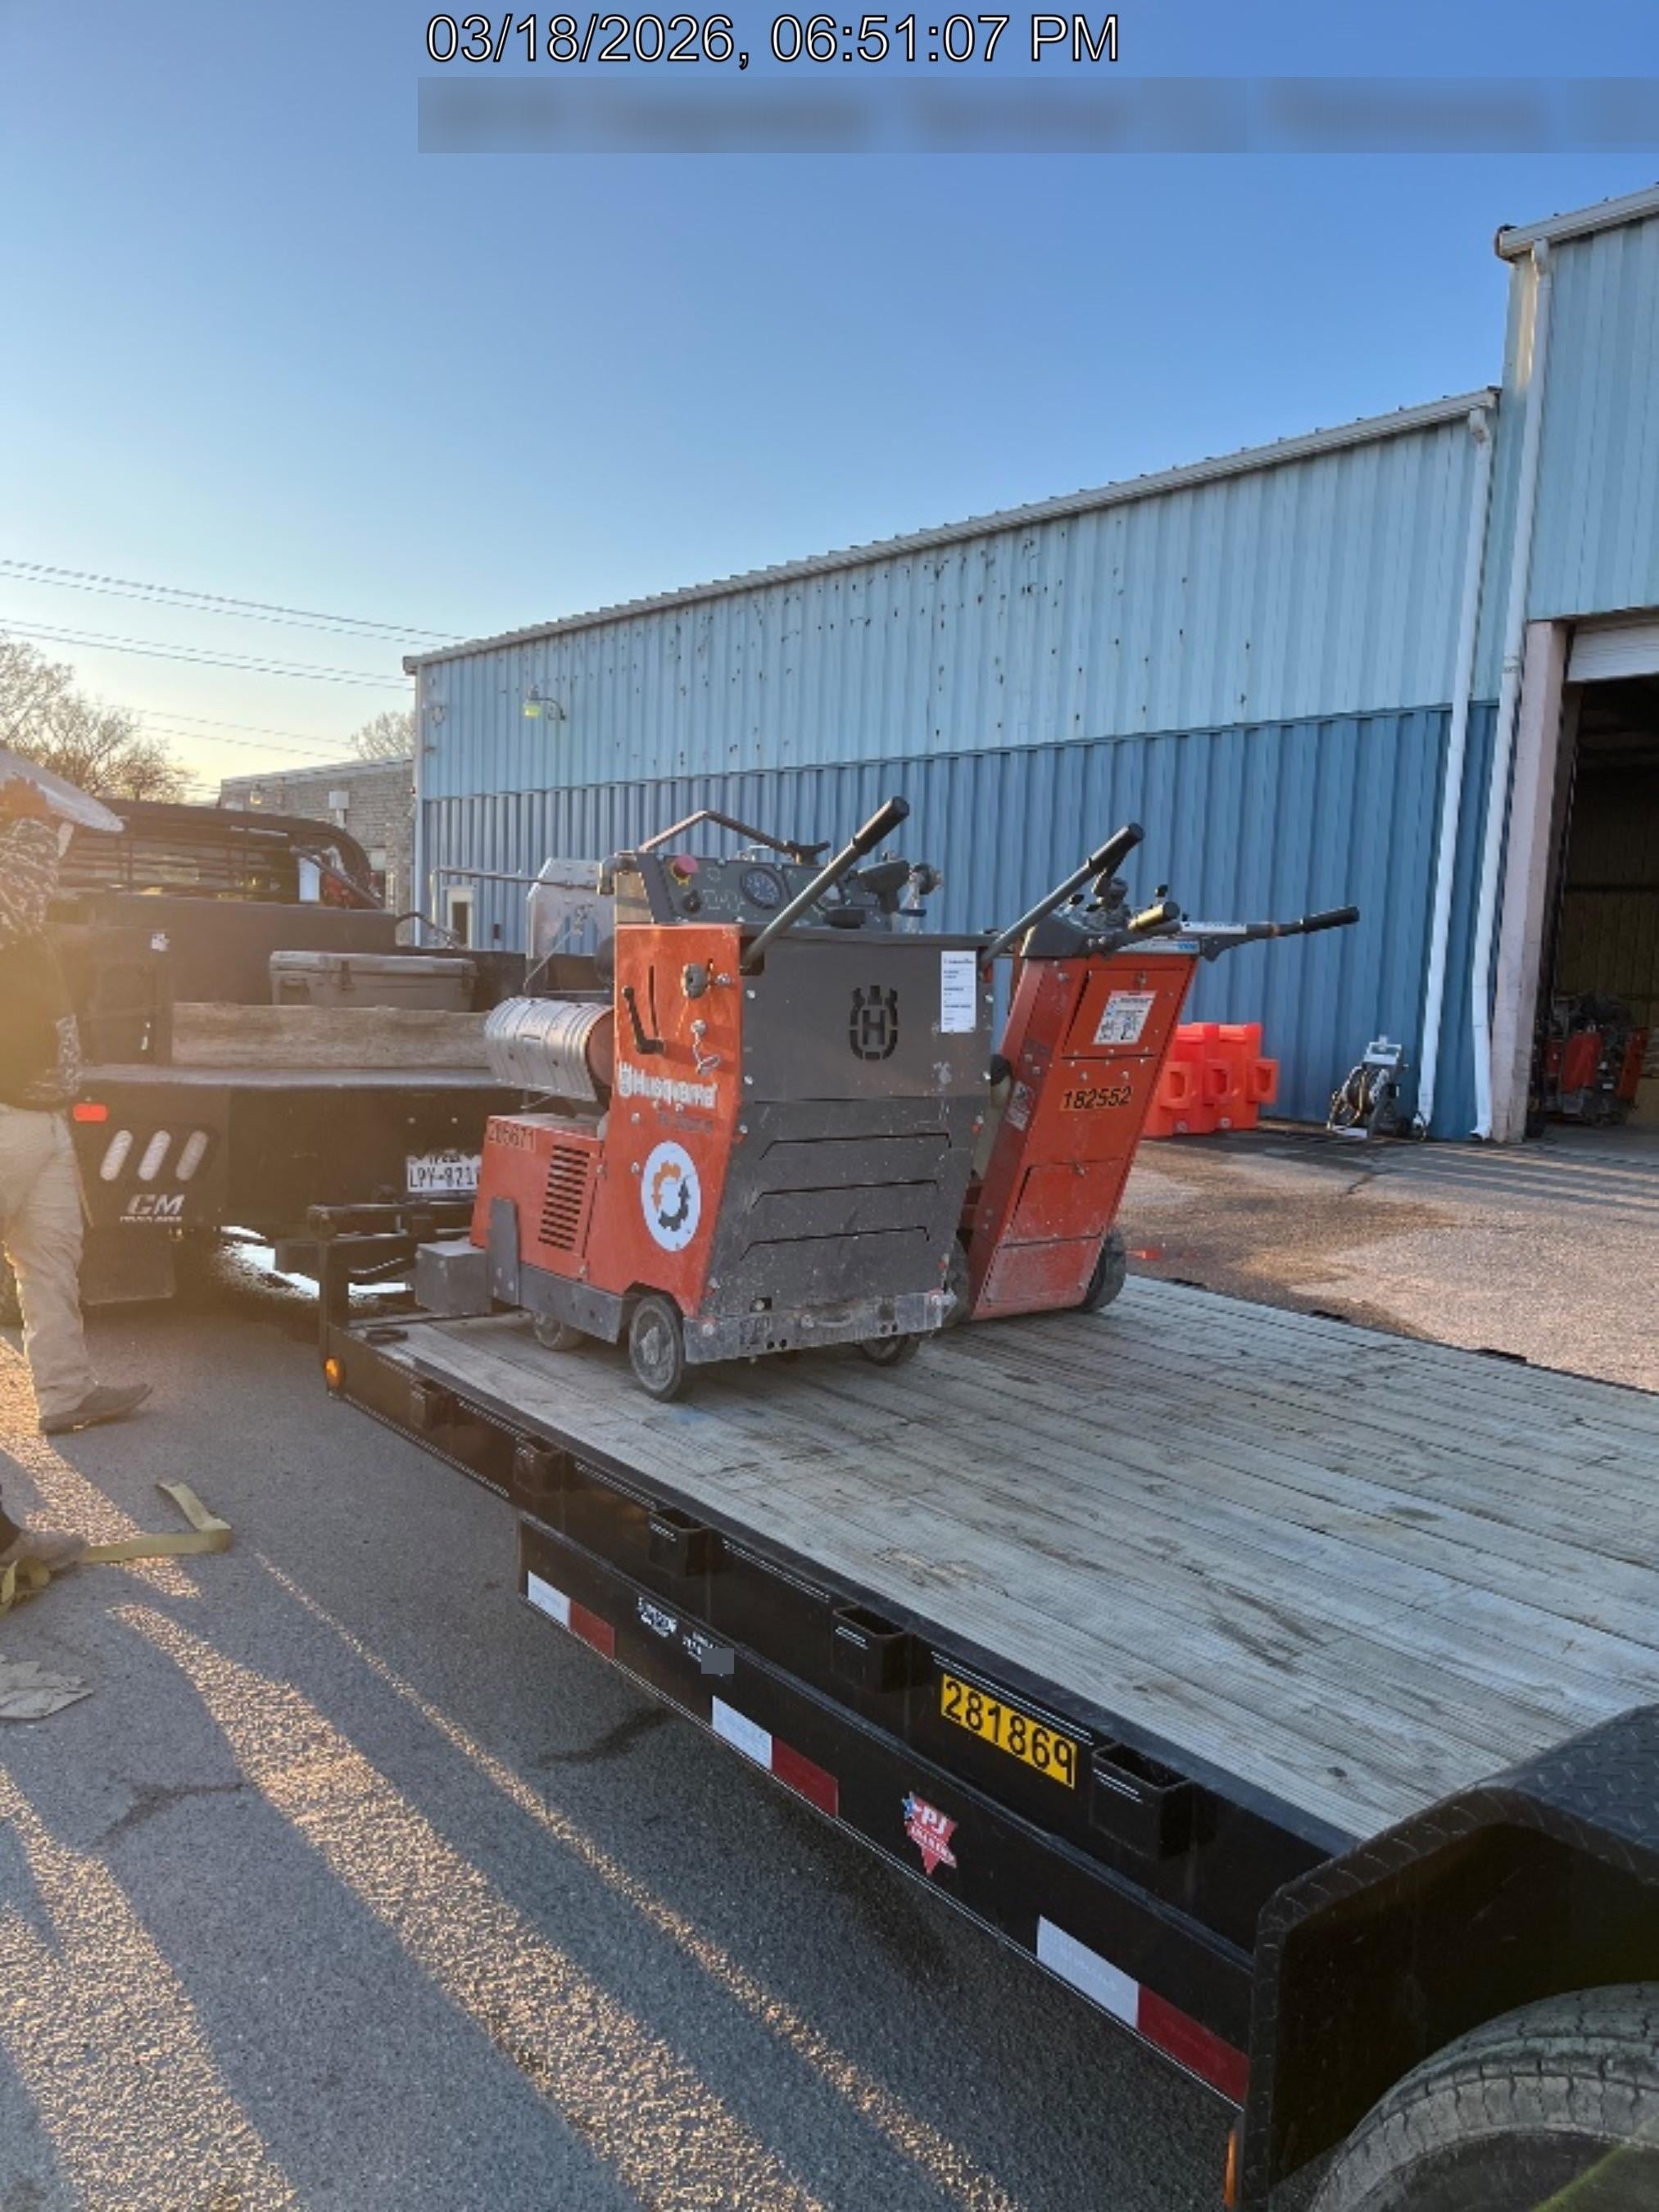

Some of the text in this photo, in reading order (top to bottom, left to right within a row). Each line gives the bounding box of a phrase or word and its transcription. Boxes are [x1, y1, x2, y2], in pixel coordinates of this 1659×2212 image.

[1063, 1086, 1131, 1109] 182552
[945, 1679, 1074, 1788] 281869
[920, 1805, 949, 1836] PJ
